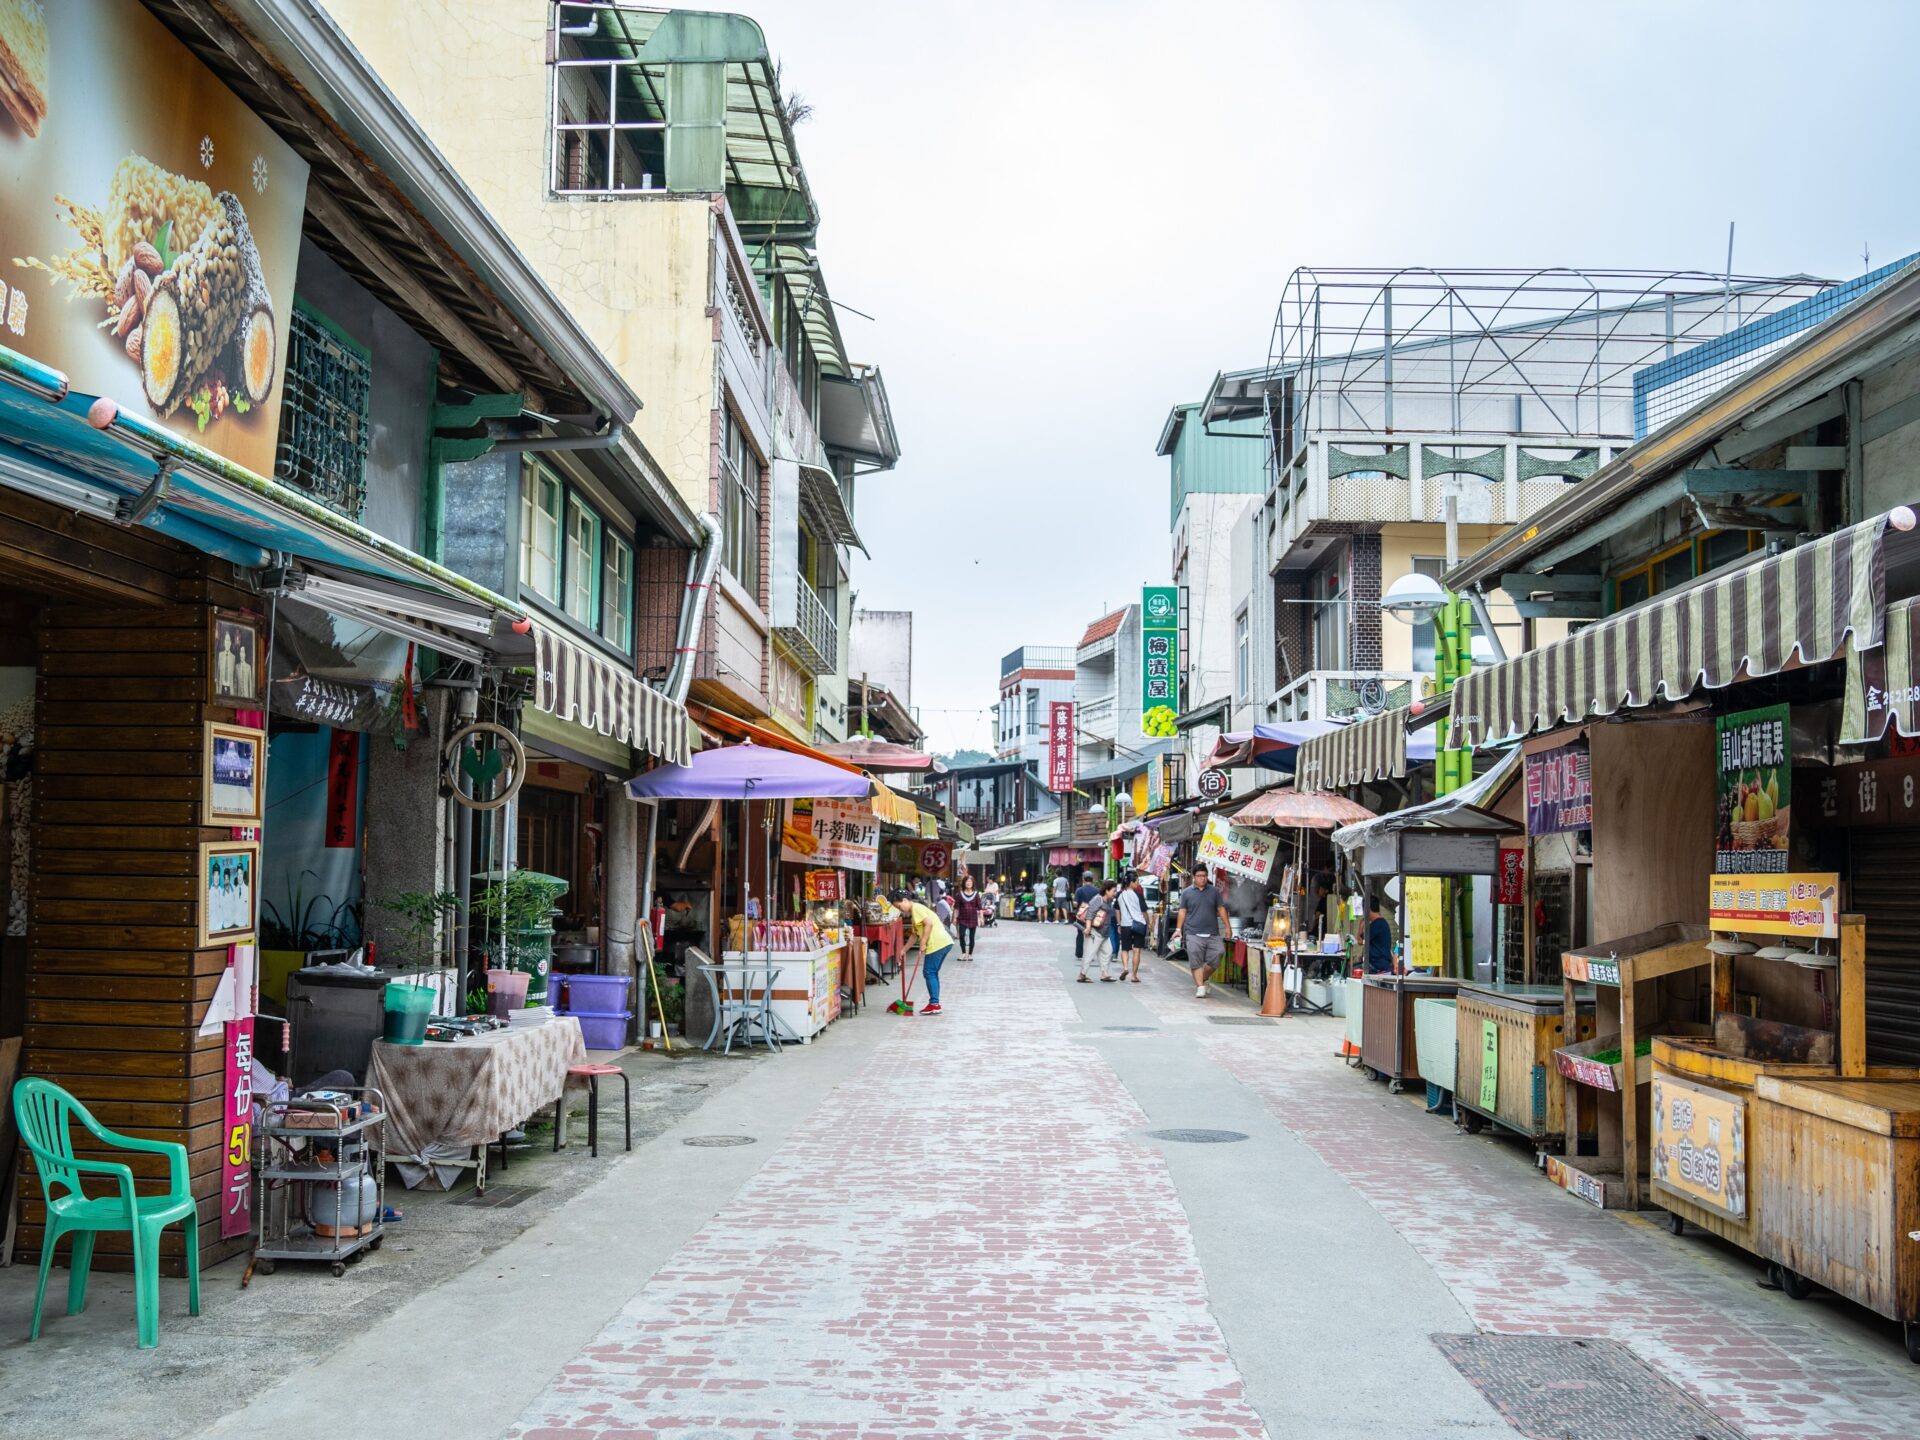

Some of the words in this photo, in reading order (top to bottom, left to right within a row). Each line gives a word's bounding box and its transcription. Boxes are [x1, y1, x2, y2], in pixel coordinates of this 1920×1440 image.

[1148, 637, 1168, 698] 梅漬屋
[1866, 685, 1882, 711] 金
[1882, 685, 1920, 706] 262128
[1056, 711, 1068, 775] 隆榮商店
[1721, 721, 1784, 772] 高山新鮮蔬果
[1201, 771, 1221, 790] 宿
[813, 819, 875, 846] 牛蒡脆片
[923, 850, 946, 868] 53
[1203, 841, 1266, 873] 小米甜甜圈
